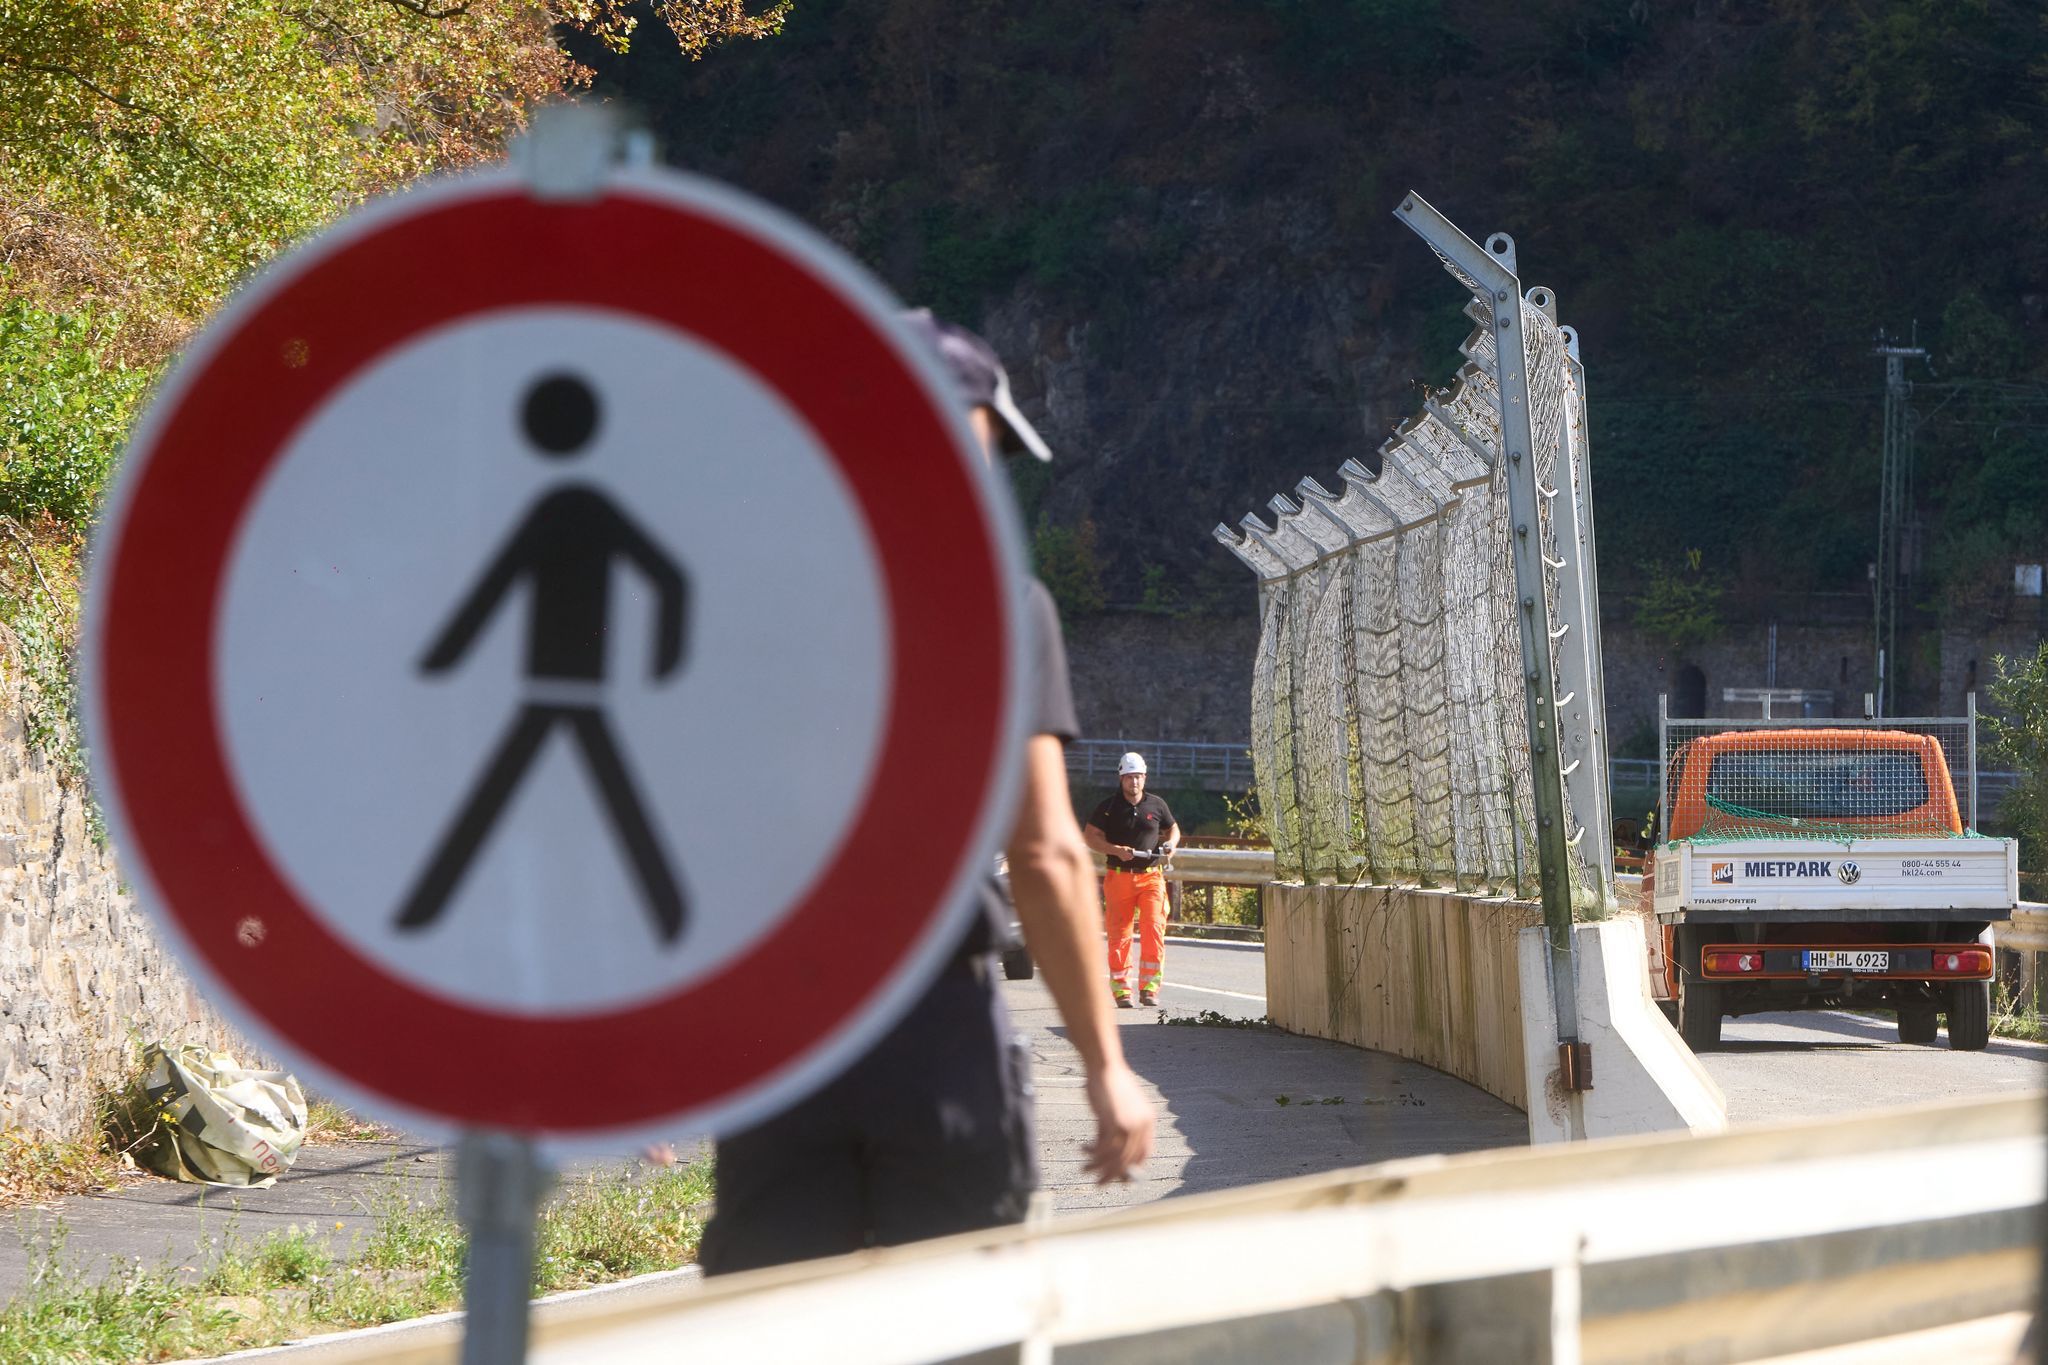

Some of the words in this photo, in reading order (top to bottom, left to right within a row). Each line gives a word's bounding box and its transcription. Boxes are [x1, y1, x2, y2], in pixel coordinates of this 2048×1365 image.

[1714, 863, 1733, 881] HKL
[1745, 861, 1832, 877] MIETPARK
[1811, 953, 1827, 966] HH
[1836, 953, 1852, 967] HL
[1856, 953, 1888, 967] 6923
